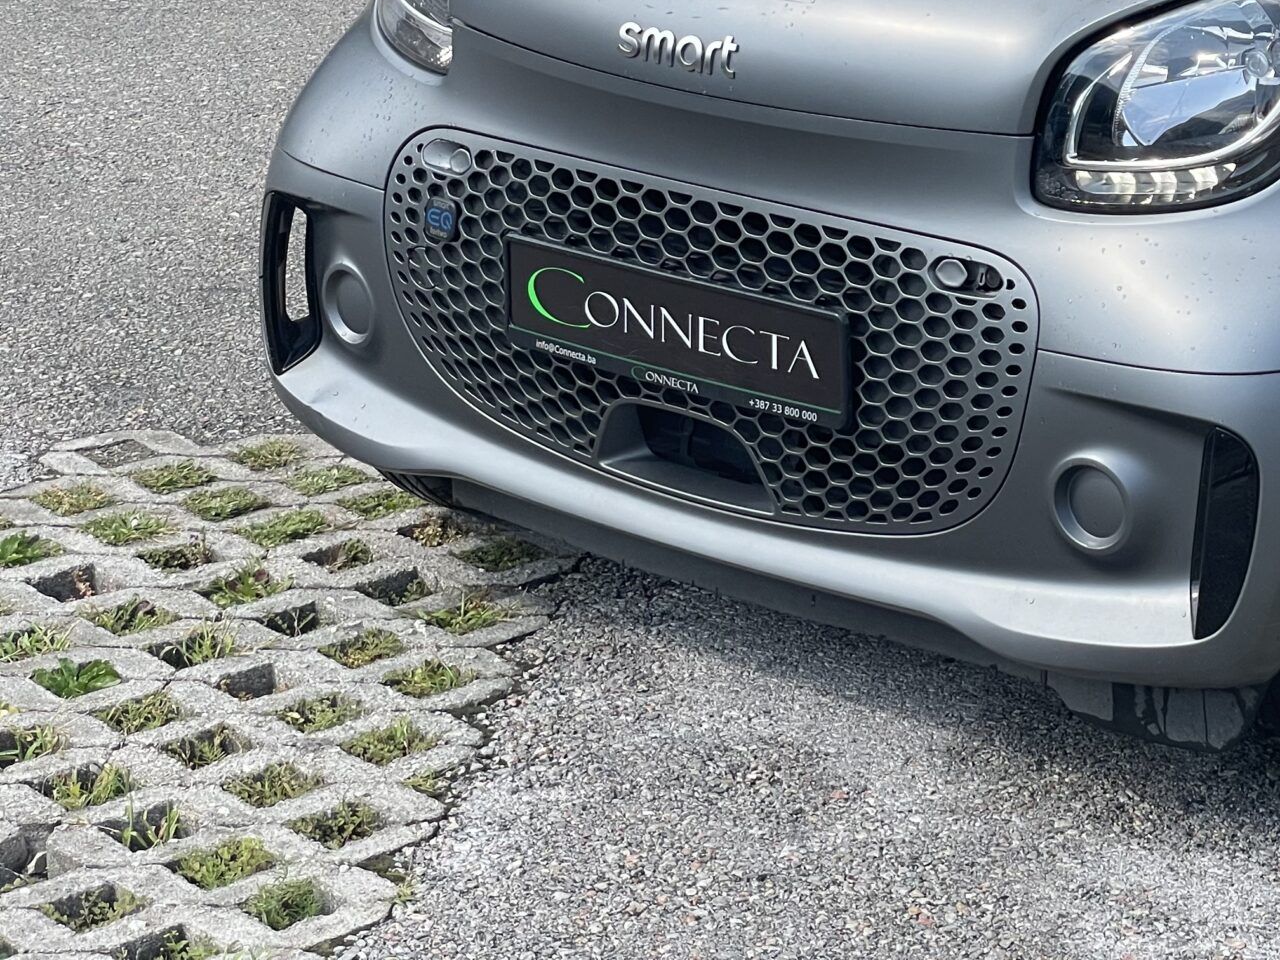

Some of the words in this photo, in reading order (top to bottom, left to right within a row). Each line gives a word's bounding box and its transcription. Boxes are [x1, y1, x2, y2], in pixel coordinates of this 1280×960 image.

[618, 21, 739, 79] smart
[527, 266, 820, 380] CONNECTA
[535, 339, 596, 365] info@Connecta.ba
[631, 366, 699, 394] CONNECTA
[749, 399, 769, 410] +387
[772, 403, 782, 413] 33
[784, 406, 800, 417] 800
[801, 410, 817, 422] 000
